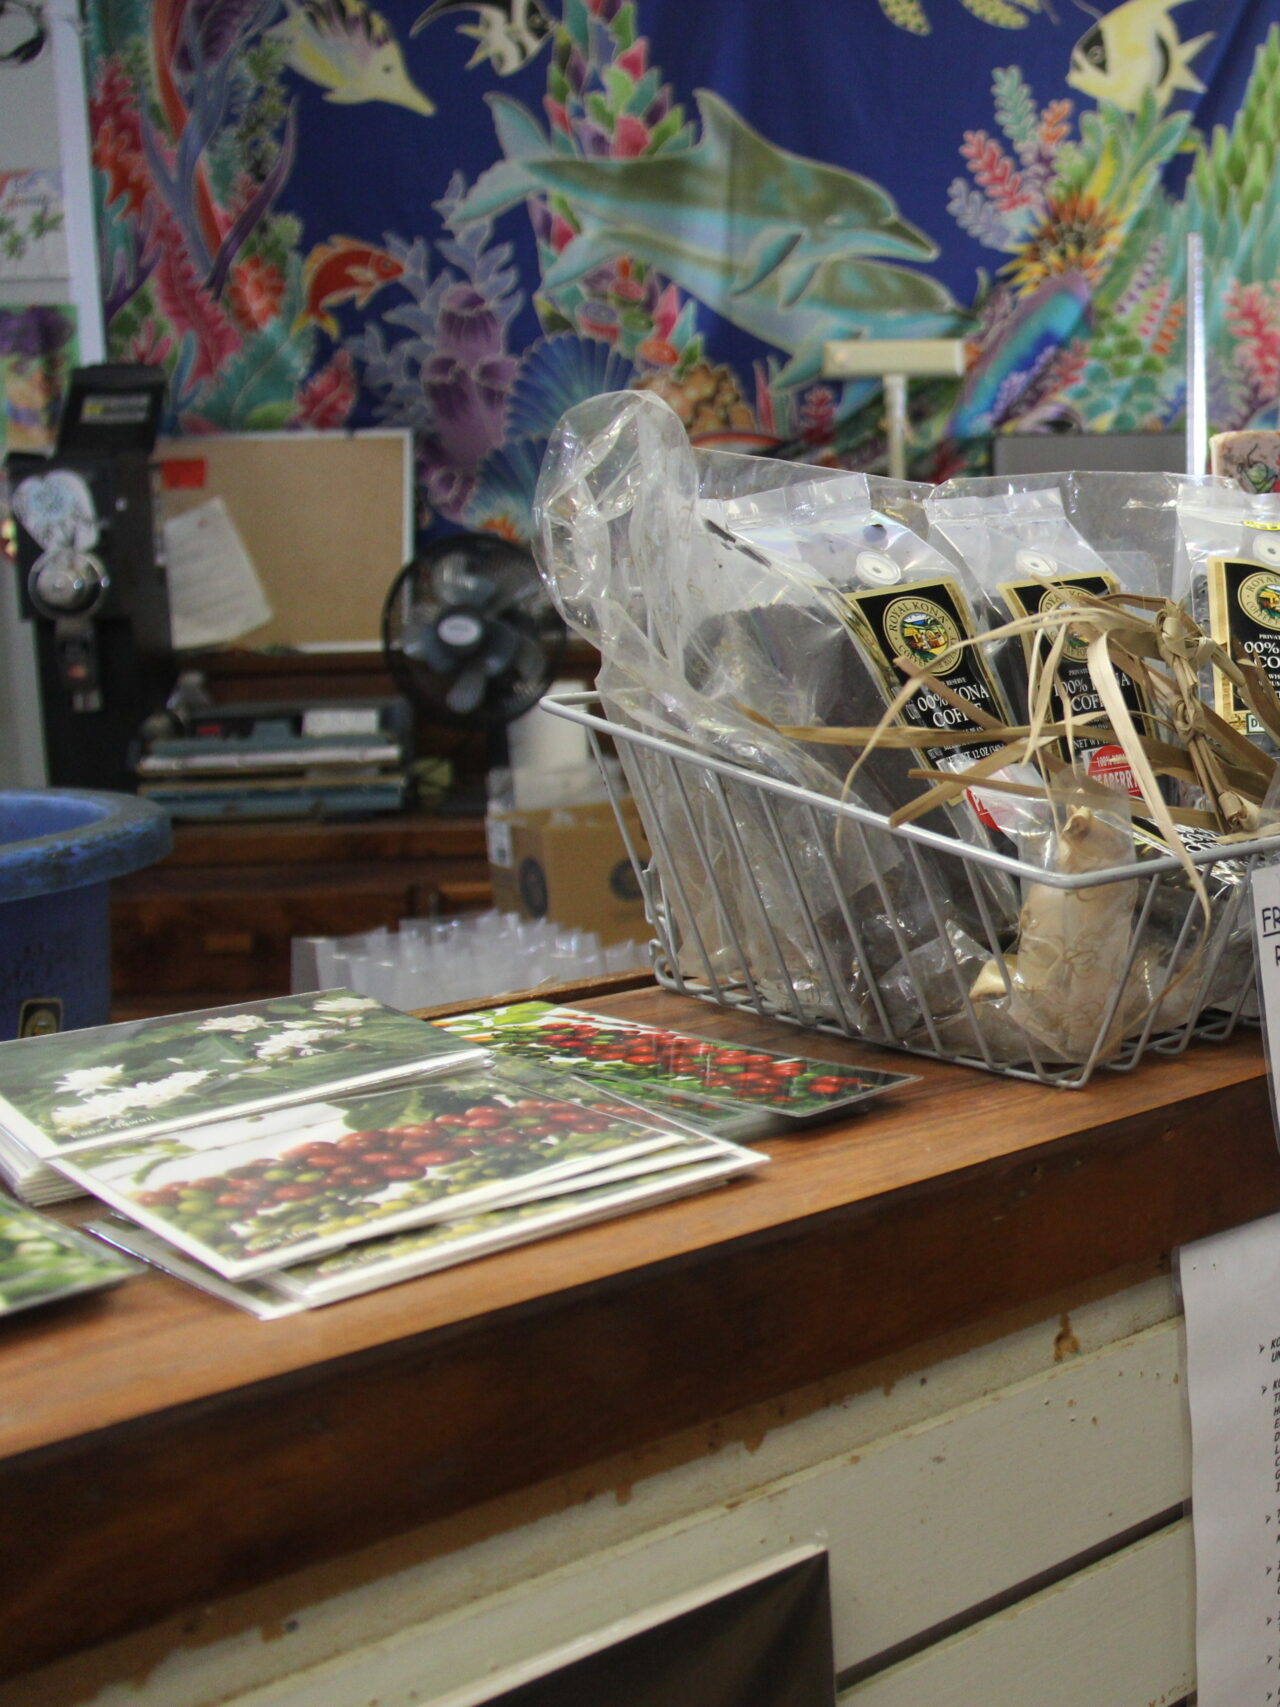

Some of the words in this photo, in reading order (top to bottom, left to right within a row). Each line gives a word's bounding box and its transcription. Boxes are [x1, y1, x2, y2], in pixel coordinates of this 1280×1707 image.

[889, 602, 911, 632] ROYAL
[912, 601, 948, 624] KONA
[1244, 641, 1280, 654] 00%
[917, 693, 949, 712] 00%
